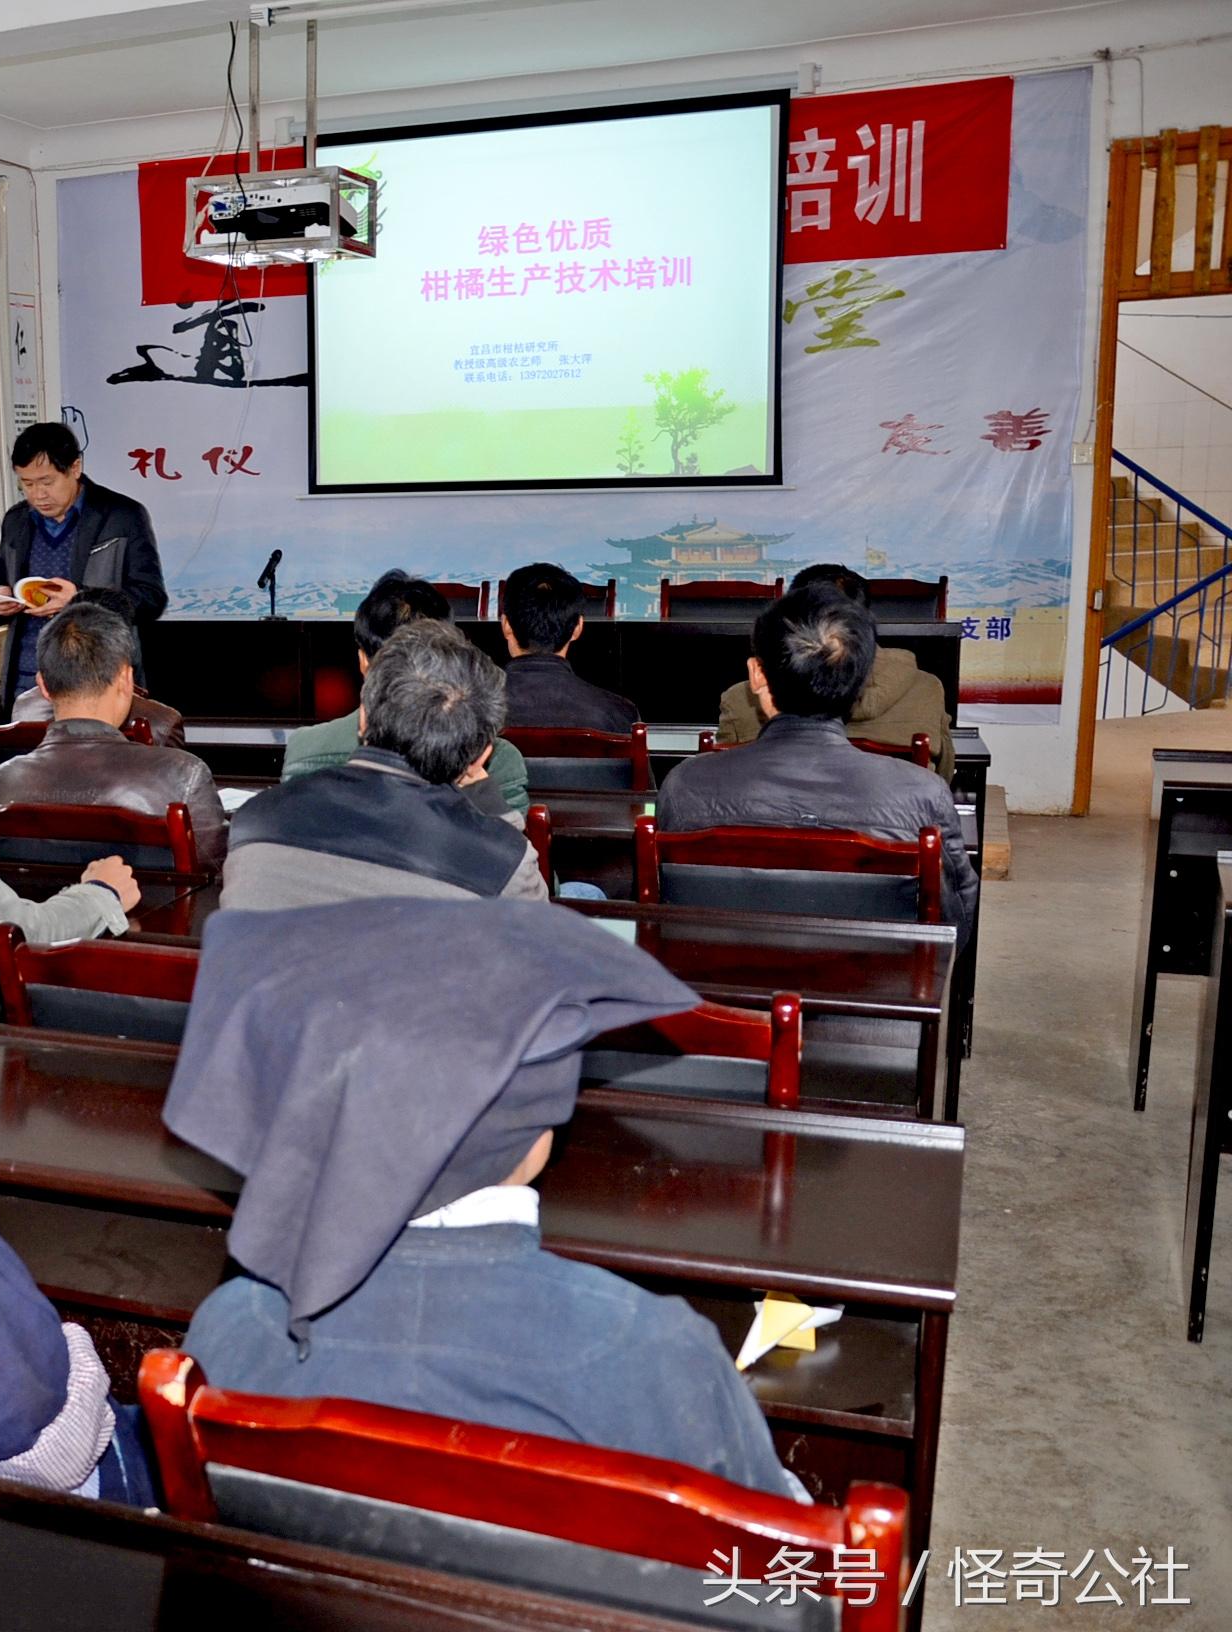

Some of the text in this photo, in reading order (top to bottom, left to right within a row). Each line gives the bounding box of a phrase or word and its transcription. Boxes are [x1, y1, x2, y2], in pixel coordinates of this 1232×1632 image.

[477, 217, 613, 257] 绿色优质
[420, 255, 693, 302] 柑橘生产技术培训
[782, 266, 906, 354] 堂
[959, 616, 1012, 641] 支部
